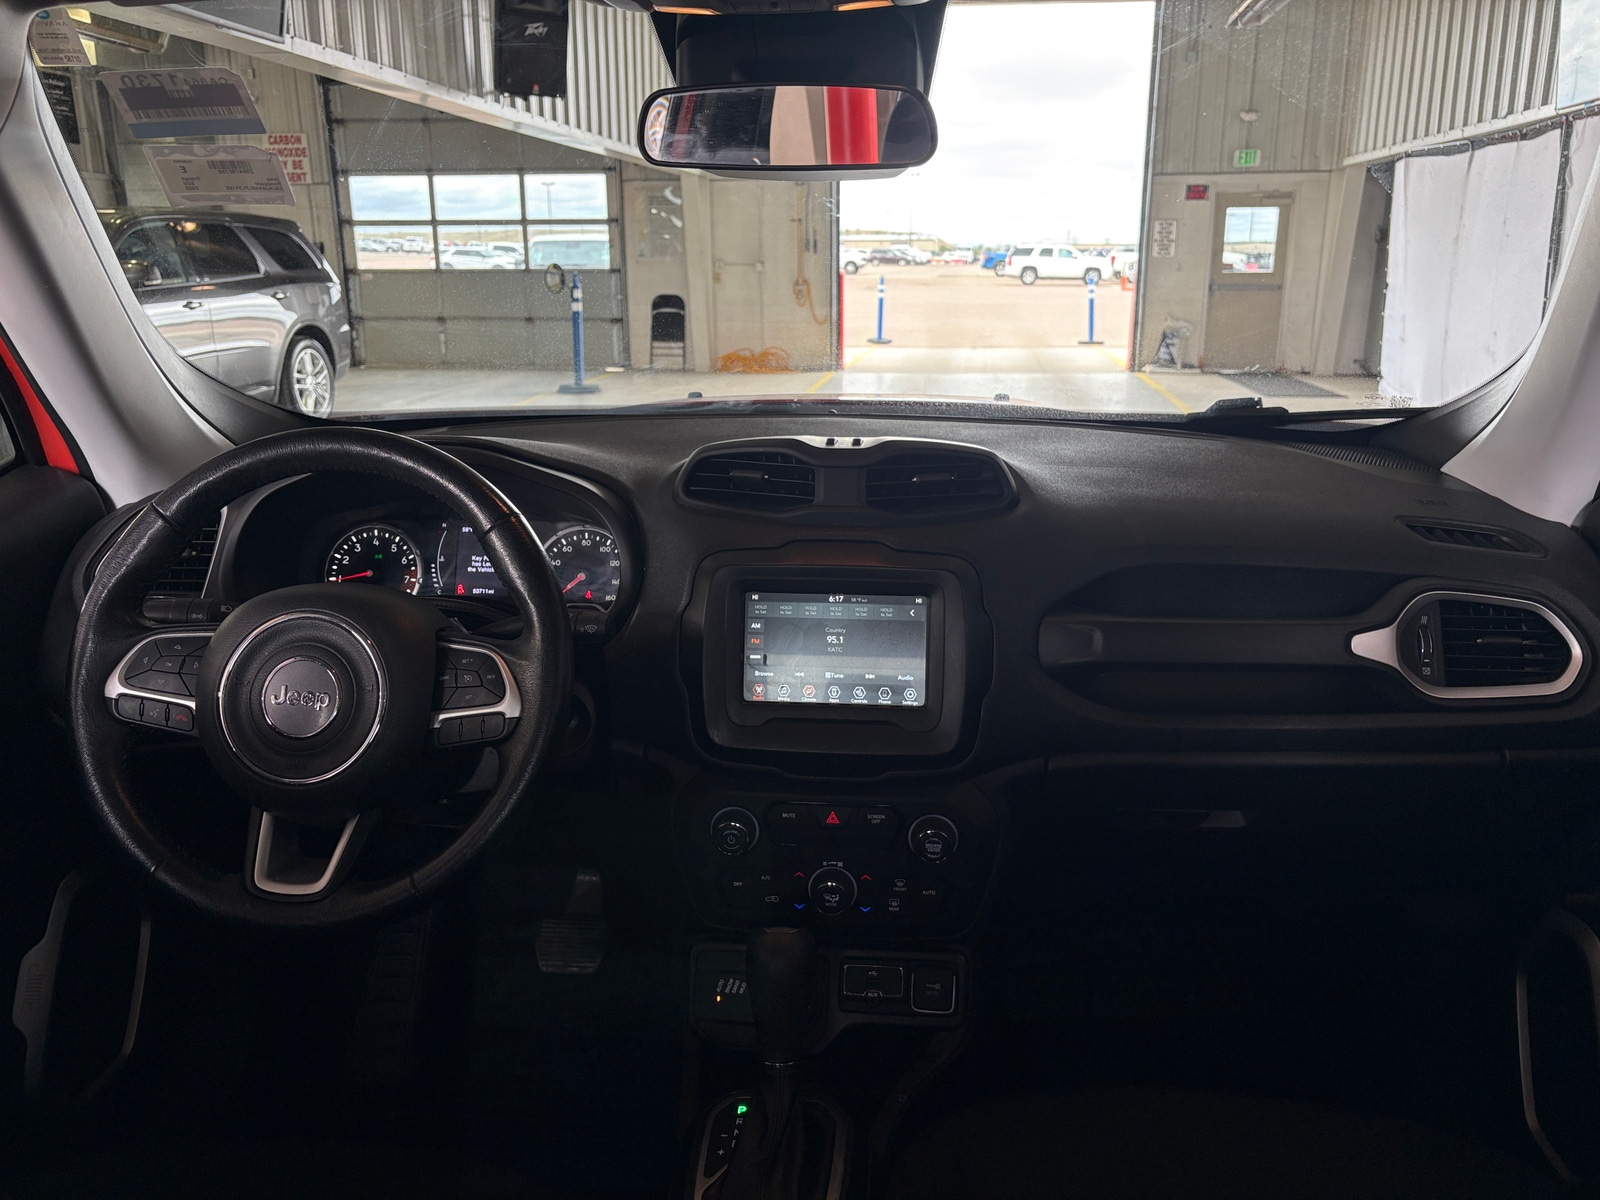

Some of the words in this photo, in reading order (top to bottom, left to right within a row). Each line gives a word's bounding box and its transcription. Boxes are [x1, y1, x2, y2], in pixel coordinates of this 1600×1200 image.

[268, 134, 302, 145] CARBON
[1237, 149, 1258, 167] EXIT
[292, 159, 303, 170] BE
[373, 537, 380, 546] 4
[581, 539, 592, 547] 80
[354, 544, 362, 553] 3
[391, 544, 398, 553] 5
[562, 545, 573, 553] 60
[342, 555, 350, 565] 2
[401, 555, 408, 565] 6
[404, 575, 410, 584] 7
[829, 595, 844, 603] 6:17
[827, 635, 843, 644] 95.1
[270, 684, 331, 711] Jeep
[716, 978, 725, 993] AUTO
[737, 1105, 748, 1115] P
[735, 1117, 744, 1125] R
